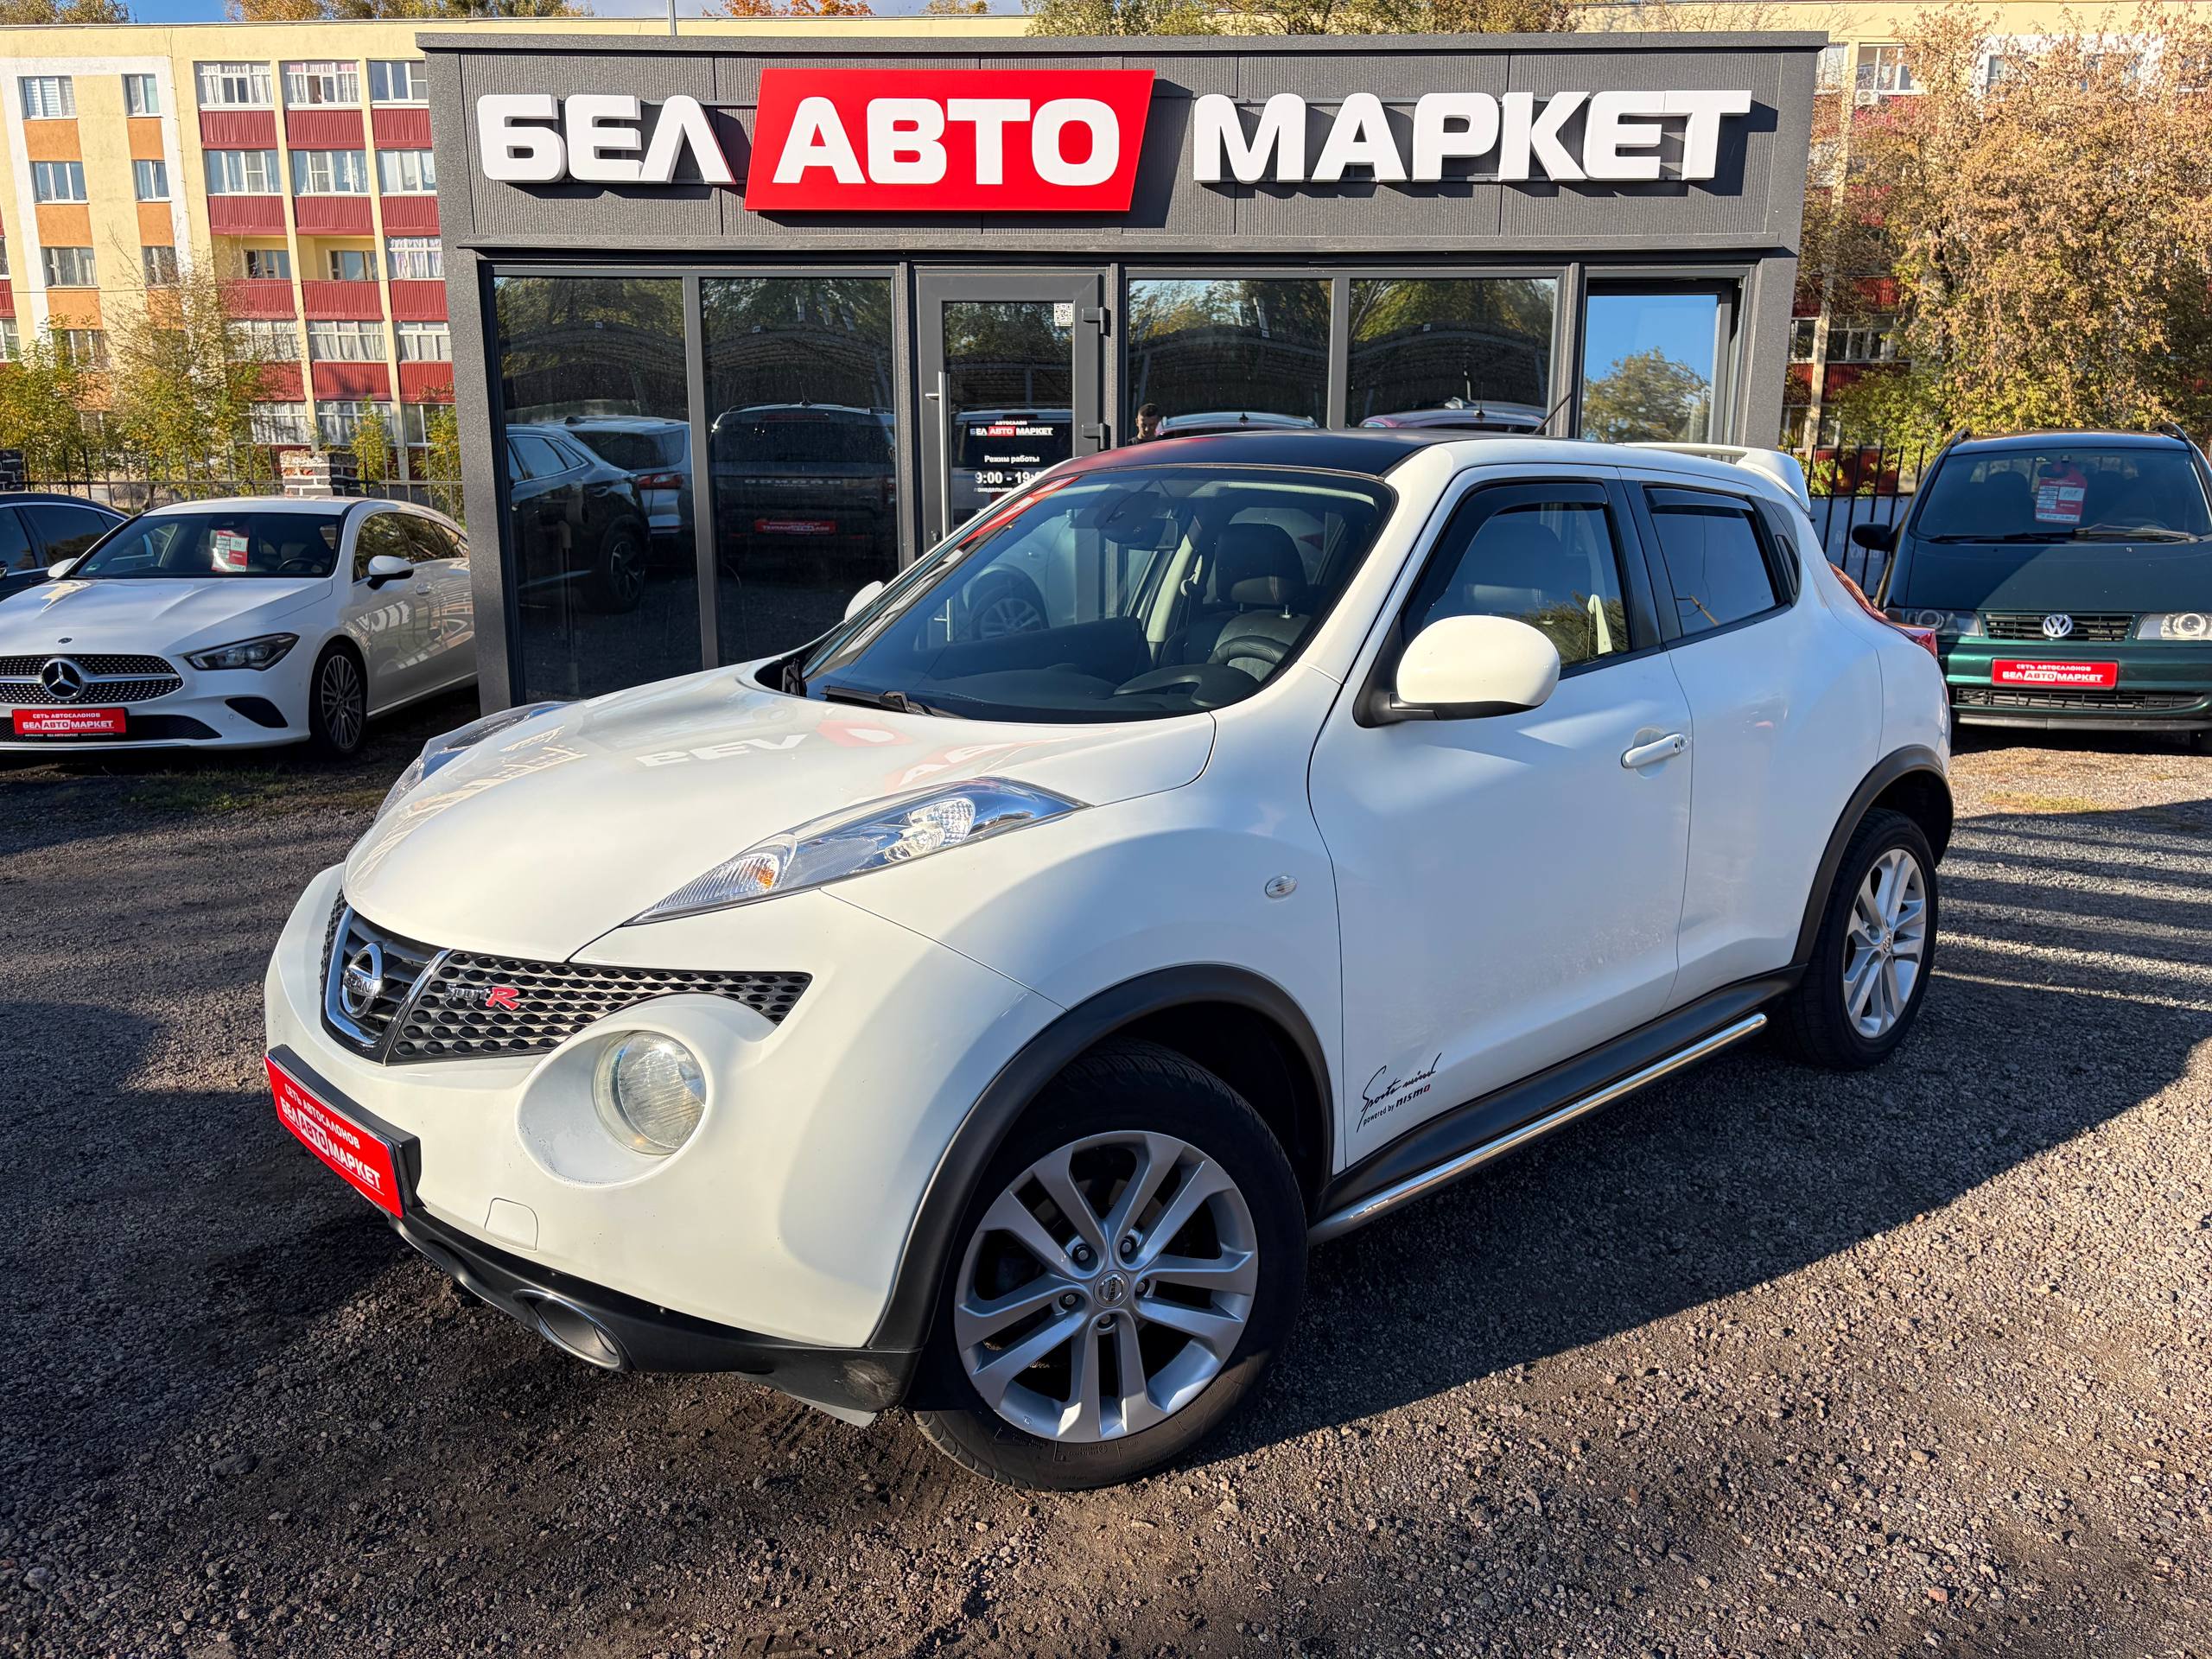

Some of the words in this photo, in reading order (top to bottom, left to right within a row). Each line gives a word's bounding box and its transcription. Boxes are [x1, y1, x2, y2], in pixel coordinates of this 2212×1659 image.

[477, 94, 737, 184] БЕЛ
[772, 96, 1121, 187] АВТО
[1193, 90, 1751, 183] МАРКЕТ
[1015, 427, 1054, 436] МАРКЕТ
[984, 454, 1010, 463] Режим
[1010, 454, 1040, 465] работы
[975, 471, 1003, 484] 9:00
[2056, 673, 2103, 682] МАРКЕТ
[70, 720, 114, 729] МАРКЕТ
[284, 1083, 302, 1107] СЕТЬ
[303, 1099, 360, 1150] АВТОСАЛОНОВ
[1363, 1107, 1387, 1127] powered
[1388, 1104, 1395, 1113] by
[280, 1096, 300, 1128] БЕЛ
[300, 1113, 327, 1150] АВТО
[327, 1139, 381, 1189] МАРКЕТ
